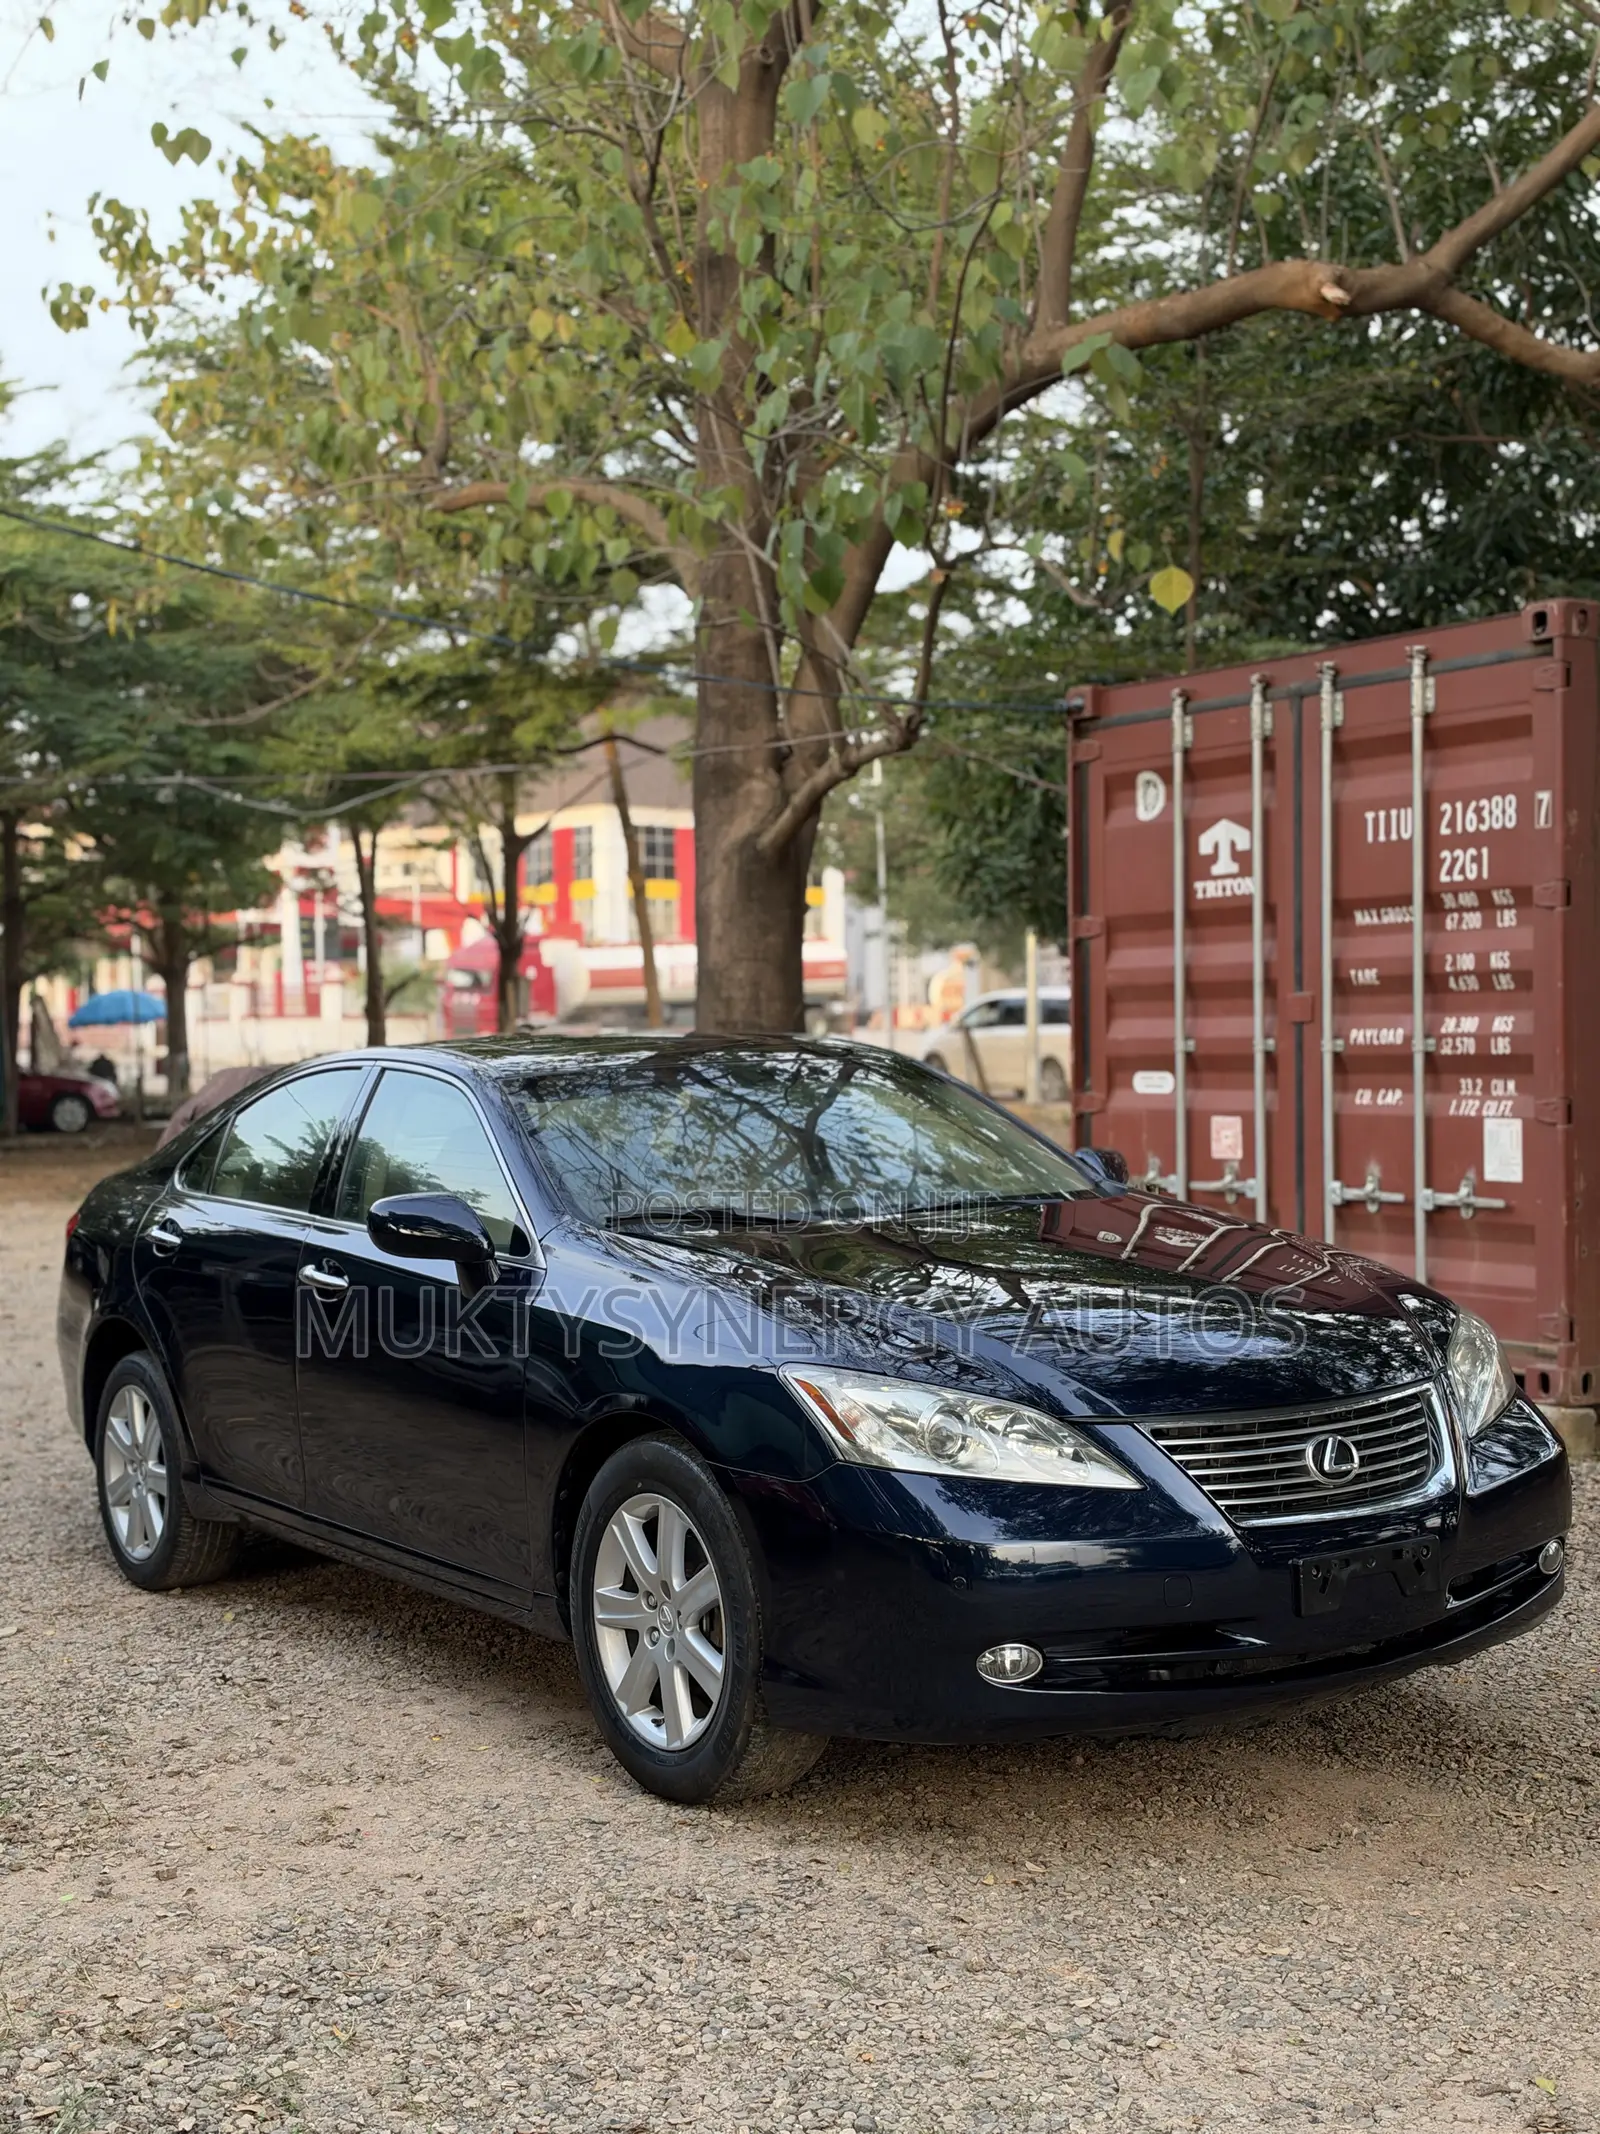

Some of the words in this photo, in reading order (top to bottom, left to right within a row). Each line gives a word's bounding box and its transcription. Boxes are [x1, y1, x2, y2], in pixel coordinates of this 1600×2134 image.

[1364, 807, 1413, 843] TIIU
[1439, 794, 1517, 835] 216388
[1535, 790, 1552, 829] 7
[1439, 847, 1489, 882] 22G1
[1193, 876, 1255, 899] TRITON
[1496, 908, 1517, 928] LBS
[1350, 1027, 1404, 1046] PAYLOAD
[1490, 1036, 1511, 1055] LBS
[1376, 1088, 1404, 1105] CAP.
[1459, 1078, 1483, 1096] 33.2
[1448, 1099, 1480, 1116] 1.172
